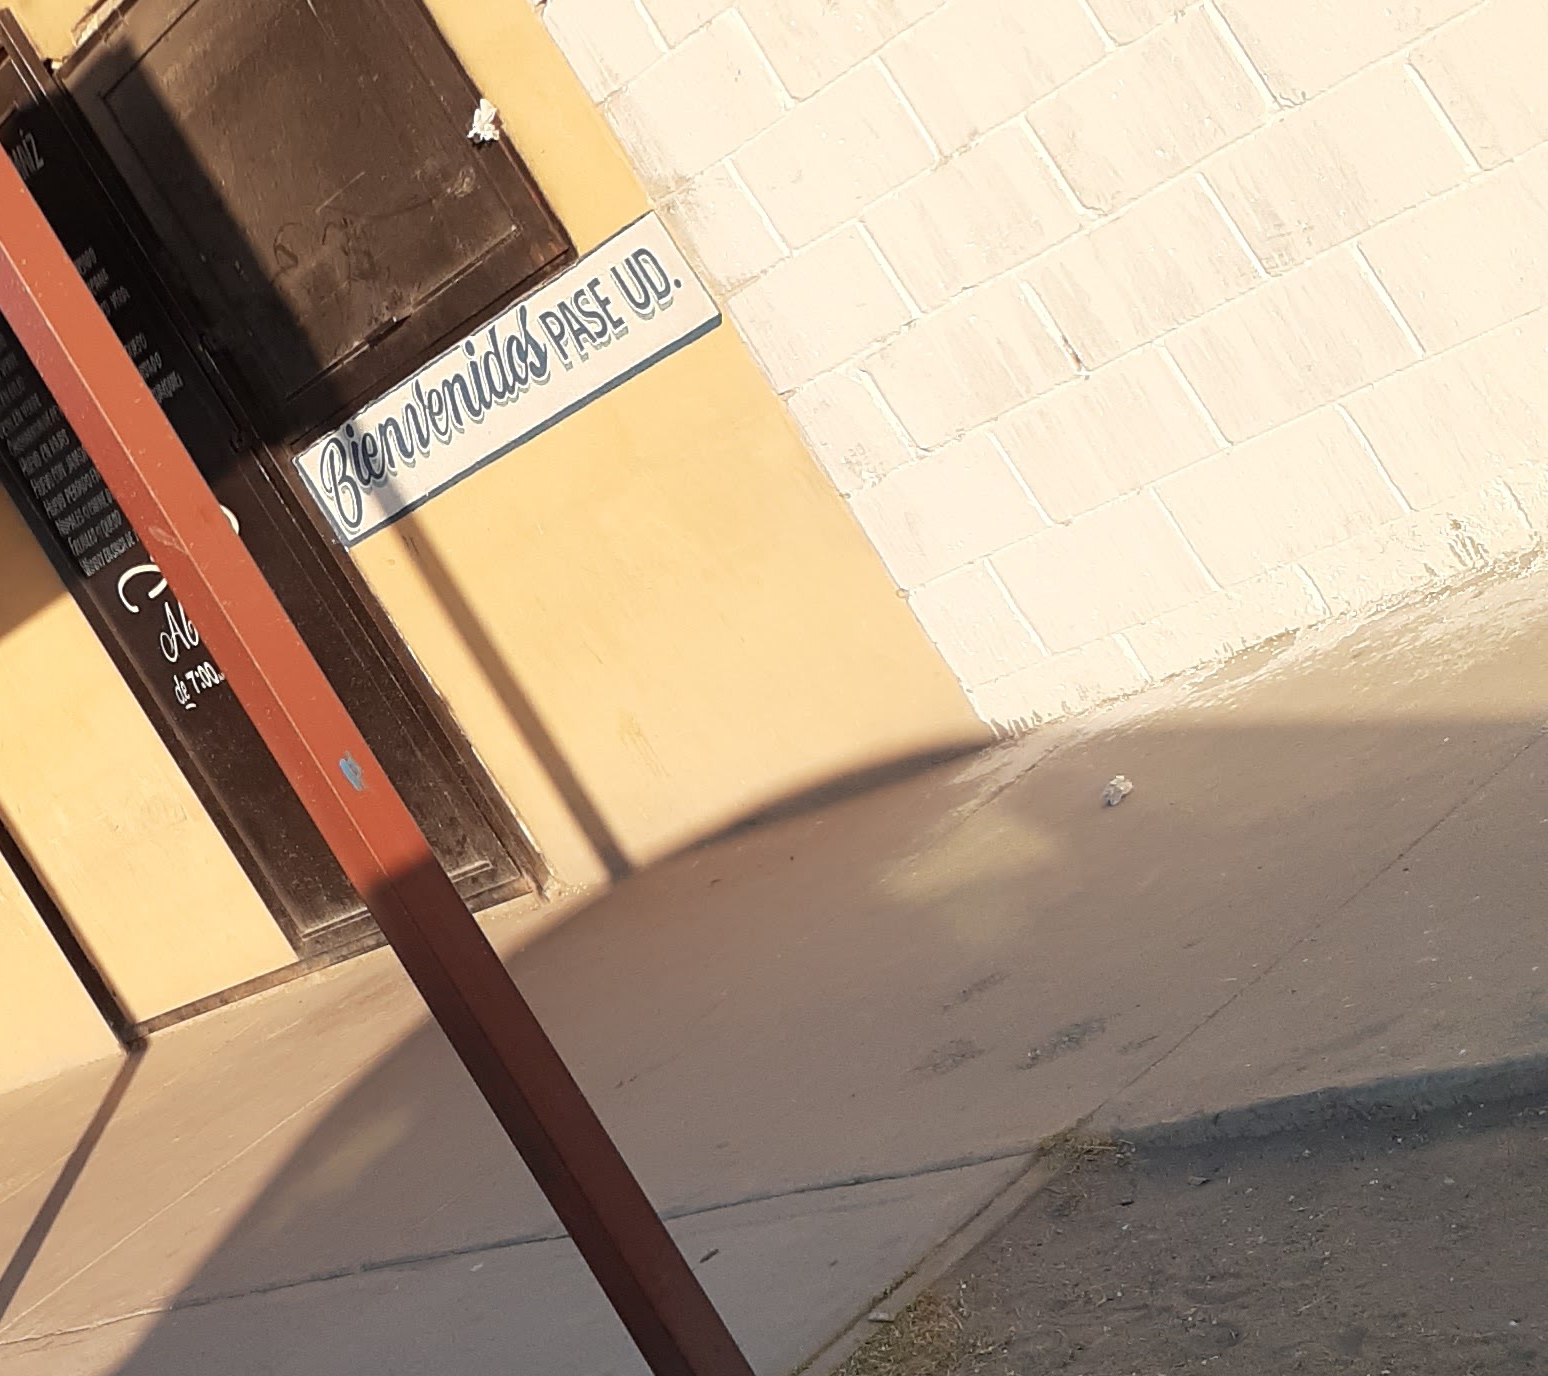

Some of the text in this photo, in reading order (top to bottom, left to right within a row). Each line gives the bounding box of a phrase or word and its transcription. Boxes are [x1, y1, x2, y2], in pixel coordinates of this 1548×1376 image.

[319, 246, 683, 531] Bienvenidos PASE UD.
